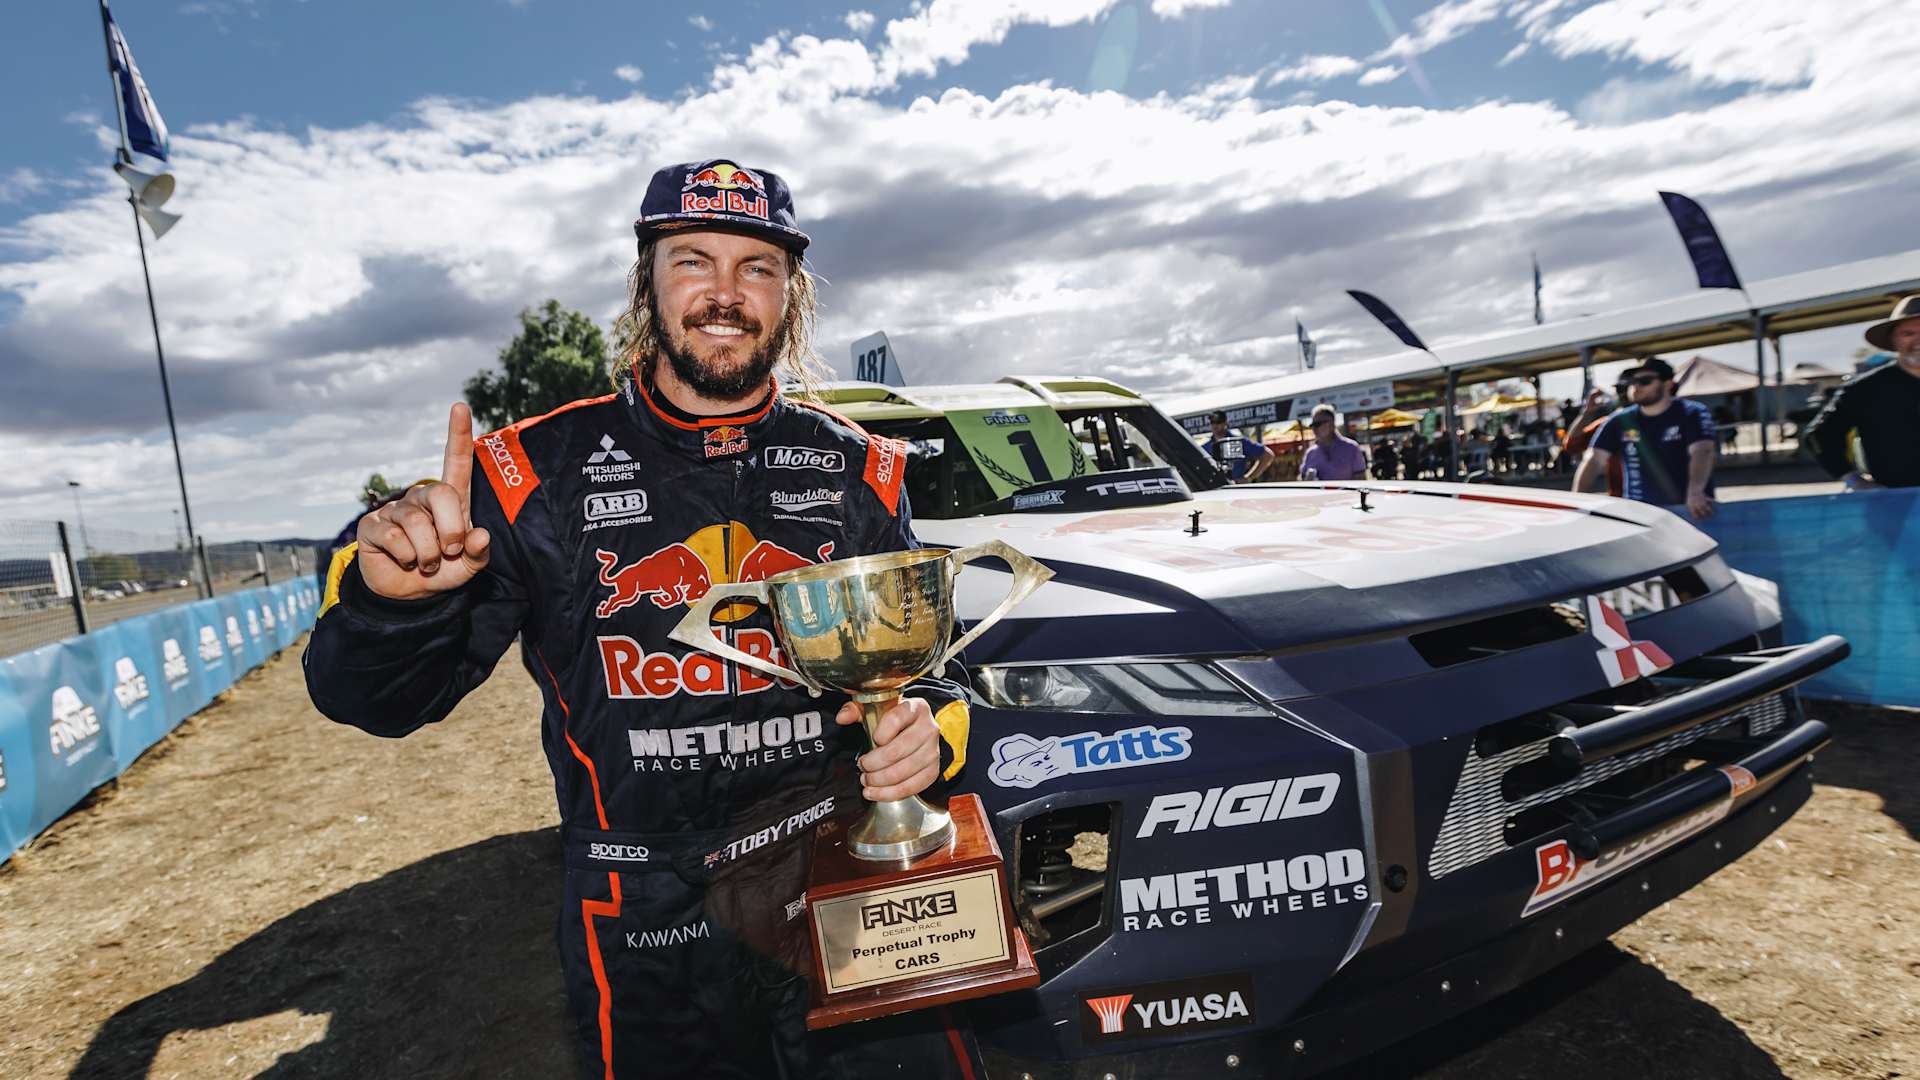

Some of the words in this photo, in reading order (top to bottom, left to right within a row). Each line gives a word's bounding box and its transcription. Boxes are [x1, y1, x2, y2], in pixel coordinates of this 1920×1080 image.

[682, 190, 725, 213] Red
[728, 191, 768, 220] Bull
[856, 345, 886, 384] 487
[984, 414, 1030, 426] FINKE
[485, 434, 523, 487] sparco
[705, 442, 728, 458] Red
[728, 439, 749, 454] Bull
[774, 449, 836, 467] MoTeC
[1007, 430, 1054, 482] 1
[582, 462, 640, 475] MITSUBISHI
[591, 471, 634, 483] MOTORS
[770, 487, 844, 504] Blundstone
[1086, 478, 1180, 496] TSCO
[590, 493, 643, 516] ARB
[600, 515, 653, 528] ACCESSORIES
[597, 626, 730, 699] Red
[628, 710, 822, 757] METHOD
[1060, 728, 1186, 769] Tatts
[633, 758, 701, 773] RACE
[719, 739, 825, 772] WHEELS
[1135, 772, 1341, 839] RIGID
[727, 818, 788, 861] TOBY
[787, 796, 835, 836] PRICE
[588, 843, 649, 861] sparco
[1119, 848, 1366, 914] METHOD
[861, 890, 957, 930] FINKE
[1123, 907, 1211, 932] RACE
[1231, 884, 1369, 920] WHEELS
[625, 920, 710, 948] KAWANA
[852, 936, 922, 959] Perpetual
[927, 928, 976, 944] Trophy
[882, 926, 917, 938] DESERT
[919, 920, 943, 931] RACE
[895, 952, 940, 970] CARS
[1133, 991, 1249, 1030] YUASA
